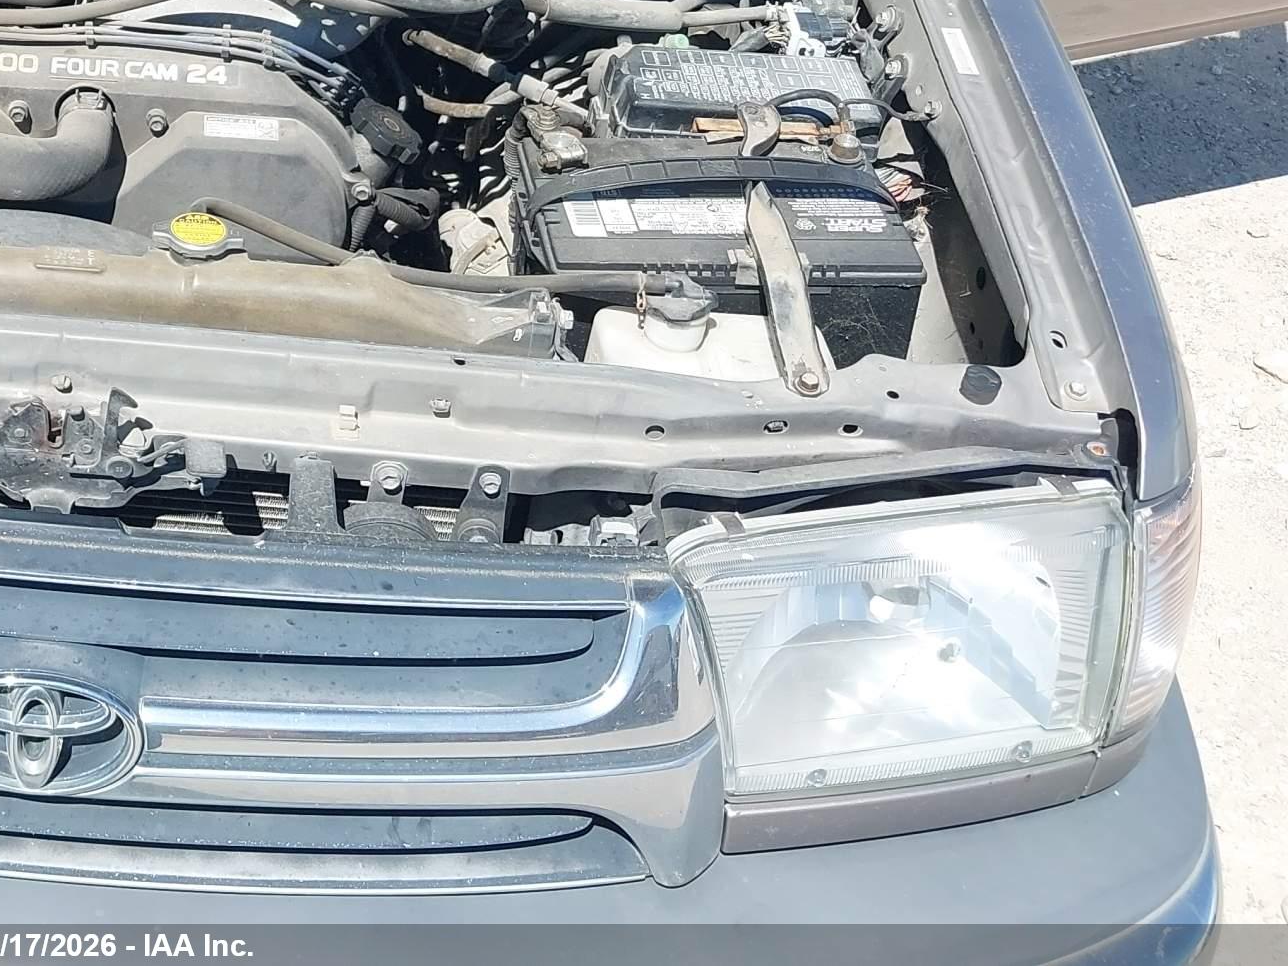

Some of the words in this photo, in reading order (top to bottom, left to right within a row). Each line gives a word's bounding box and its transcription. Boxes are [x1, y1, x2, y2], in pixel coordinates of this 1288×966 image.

[51, 56, 120, 77] FOUR
[125, 61, 178, 82] CAM
[186, 64, 228, 85] 24
[824, 218, 887, 226] START
